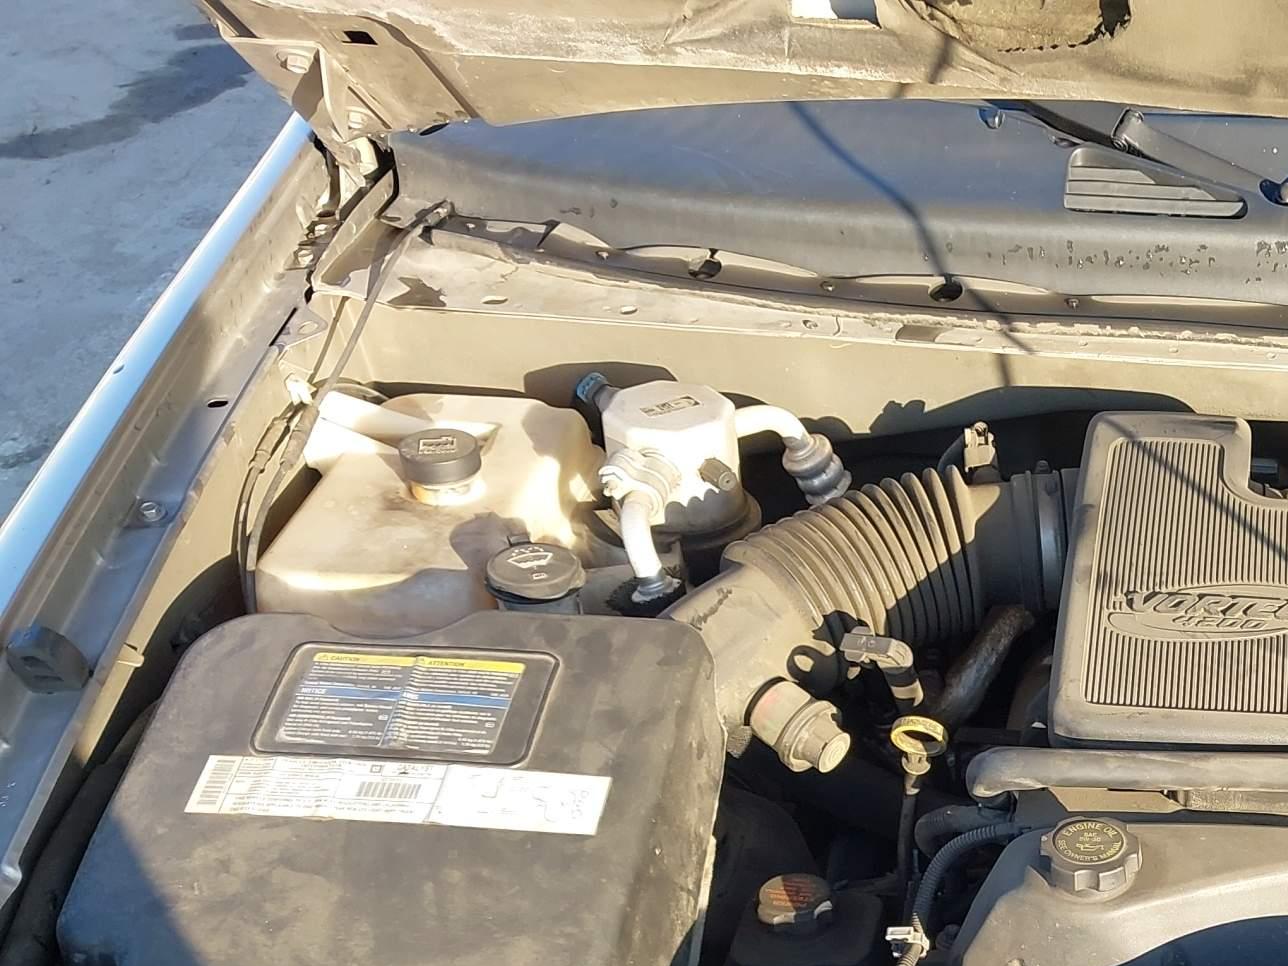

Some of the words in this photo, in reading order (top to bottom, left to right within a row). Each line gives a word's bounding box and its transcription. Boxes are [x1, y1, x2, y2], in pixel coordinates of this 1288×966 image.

[1172, 616, 1267, 630] 4200
[428, 660, 465, 668] ATTENTION
[301, 687, 327, 695] NOTICE
[1063, 822, 1103, 837] ENGINE
[1103, 826, 1118, 838] OIL
[1058, 839, 1068, 850] SEE
[1098, 840, 1122, 859] MANUAL
